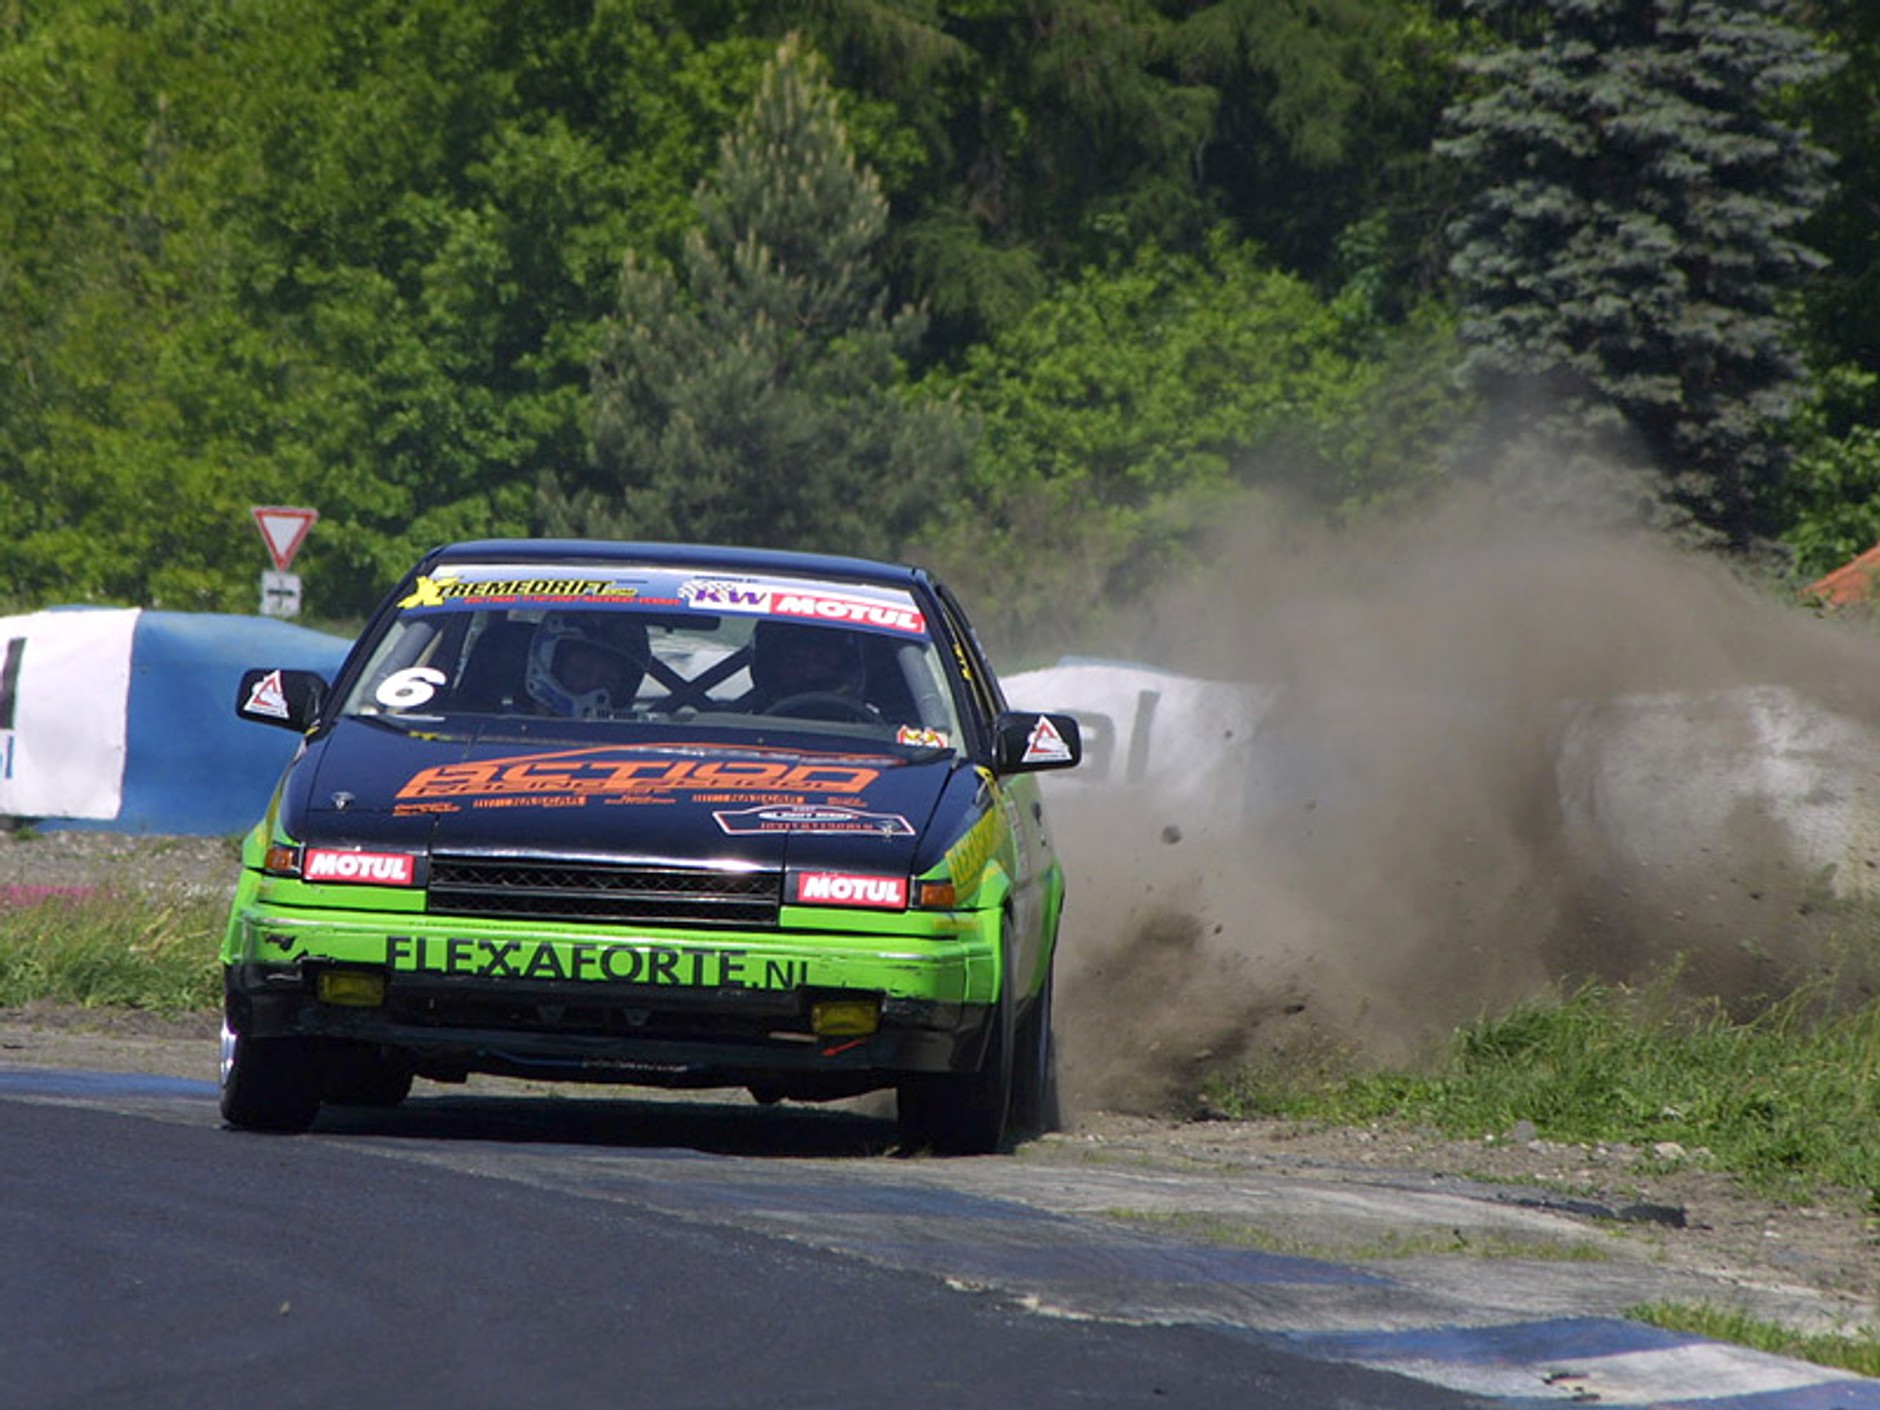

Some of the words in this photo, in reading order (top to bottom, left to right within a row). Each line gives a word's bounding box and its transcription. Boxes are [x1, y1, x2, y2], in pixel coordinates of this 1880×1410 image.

[776, 596, 918, 629] MOTUL
[376, 667, 448, 706] 6
[309, 853, 407, 880] MOTUL
[803, 876, 902, 903] MOTUL
